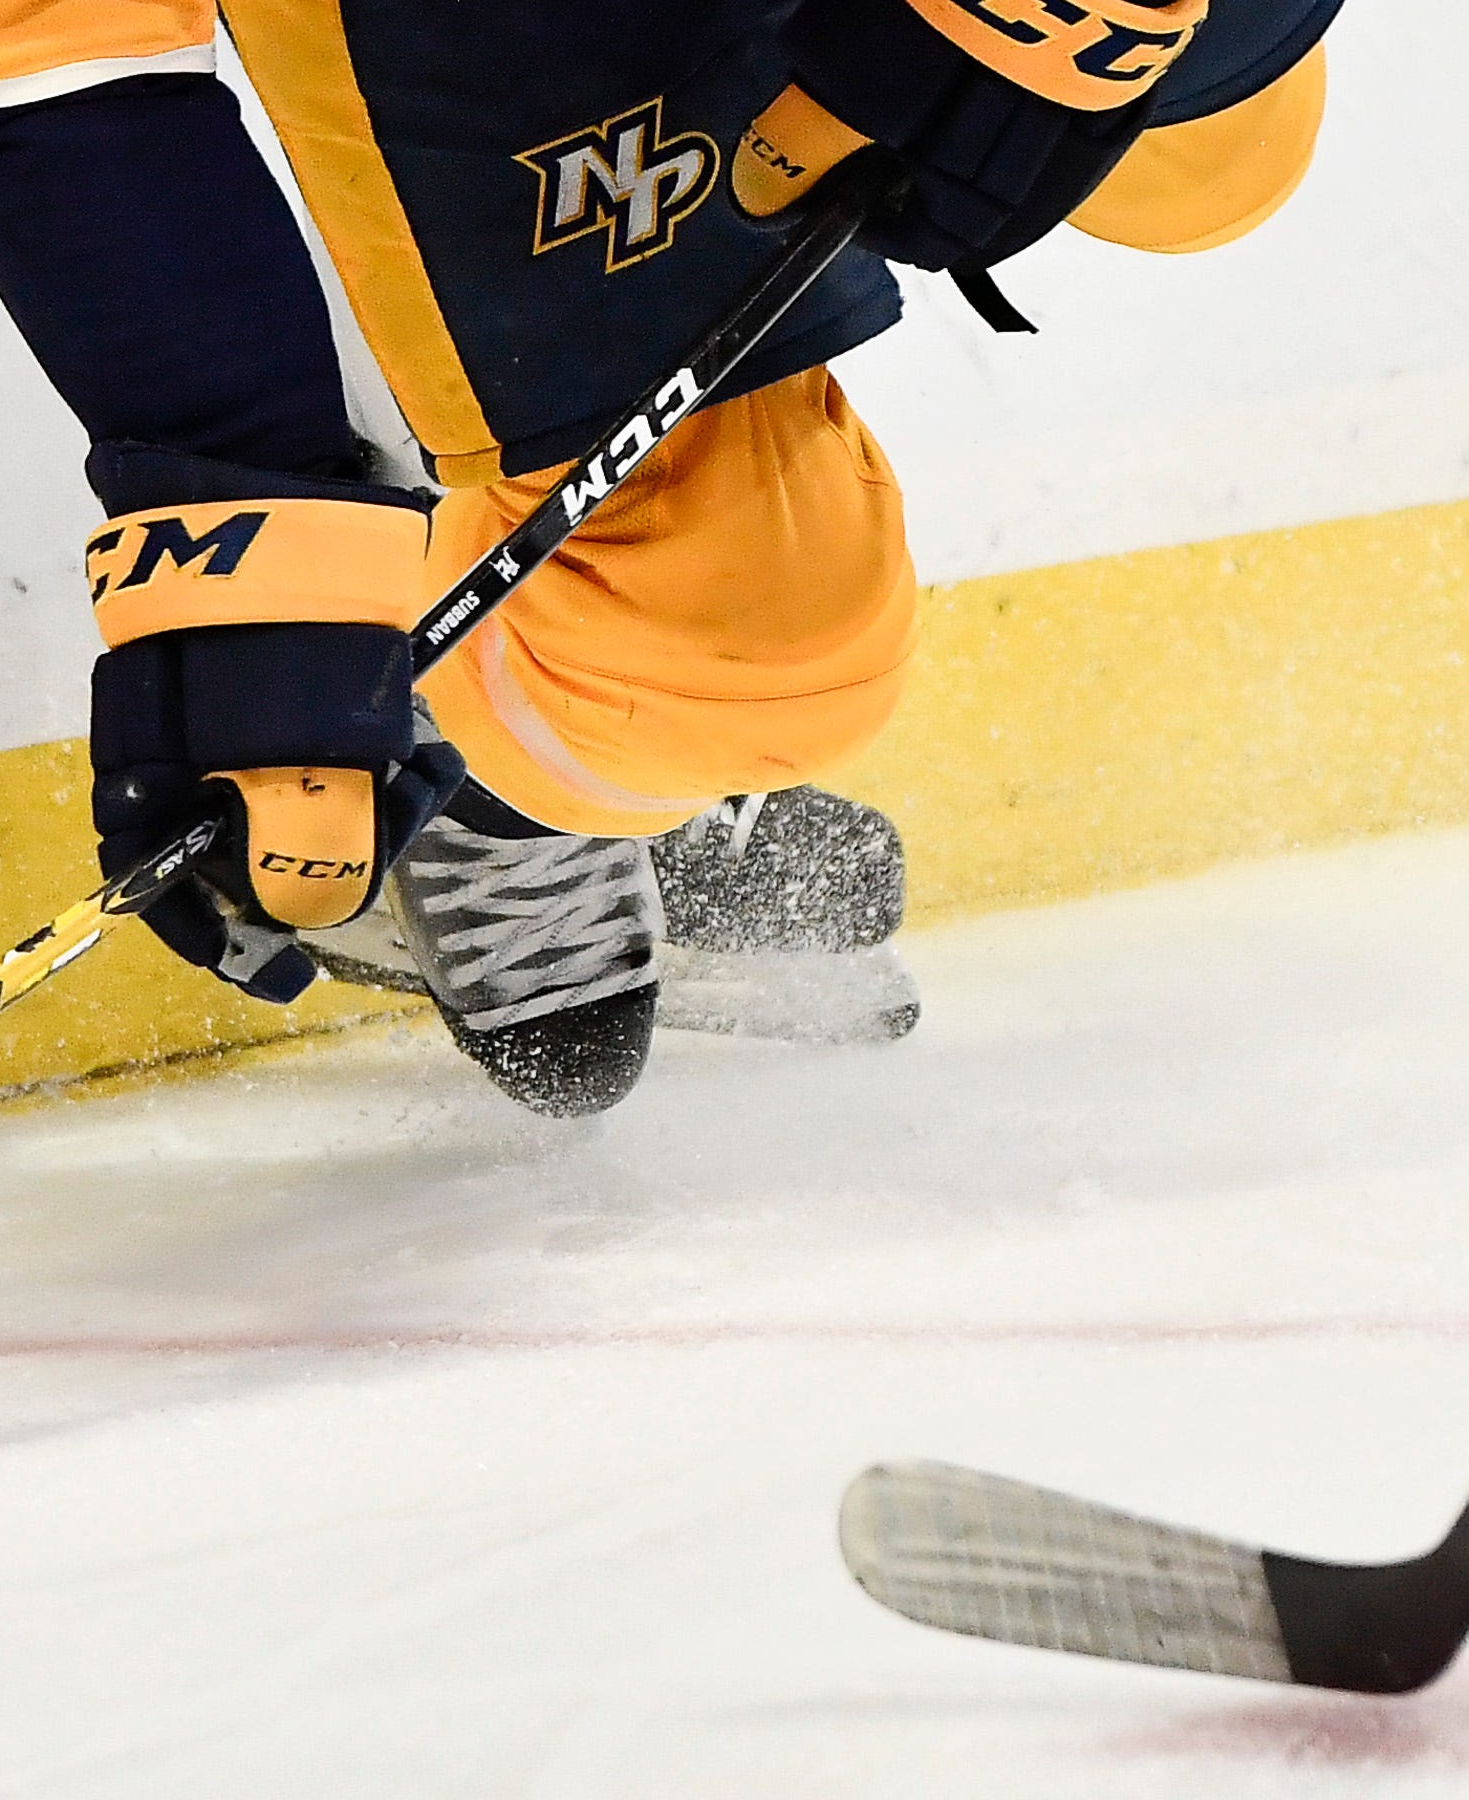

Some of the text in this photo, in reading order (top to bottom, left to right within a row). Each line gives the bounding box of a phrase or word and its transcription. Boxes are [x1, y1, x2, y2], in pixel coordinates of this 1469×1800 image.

[560, 366, 705, 528] CCM
[425, 590, 481, 646] SUBBAN
[258, 851, 368, 879] CCM
